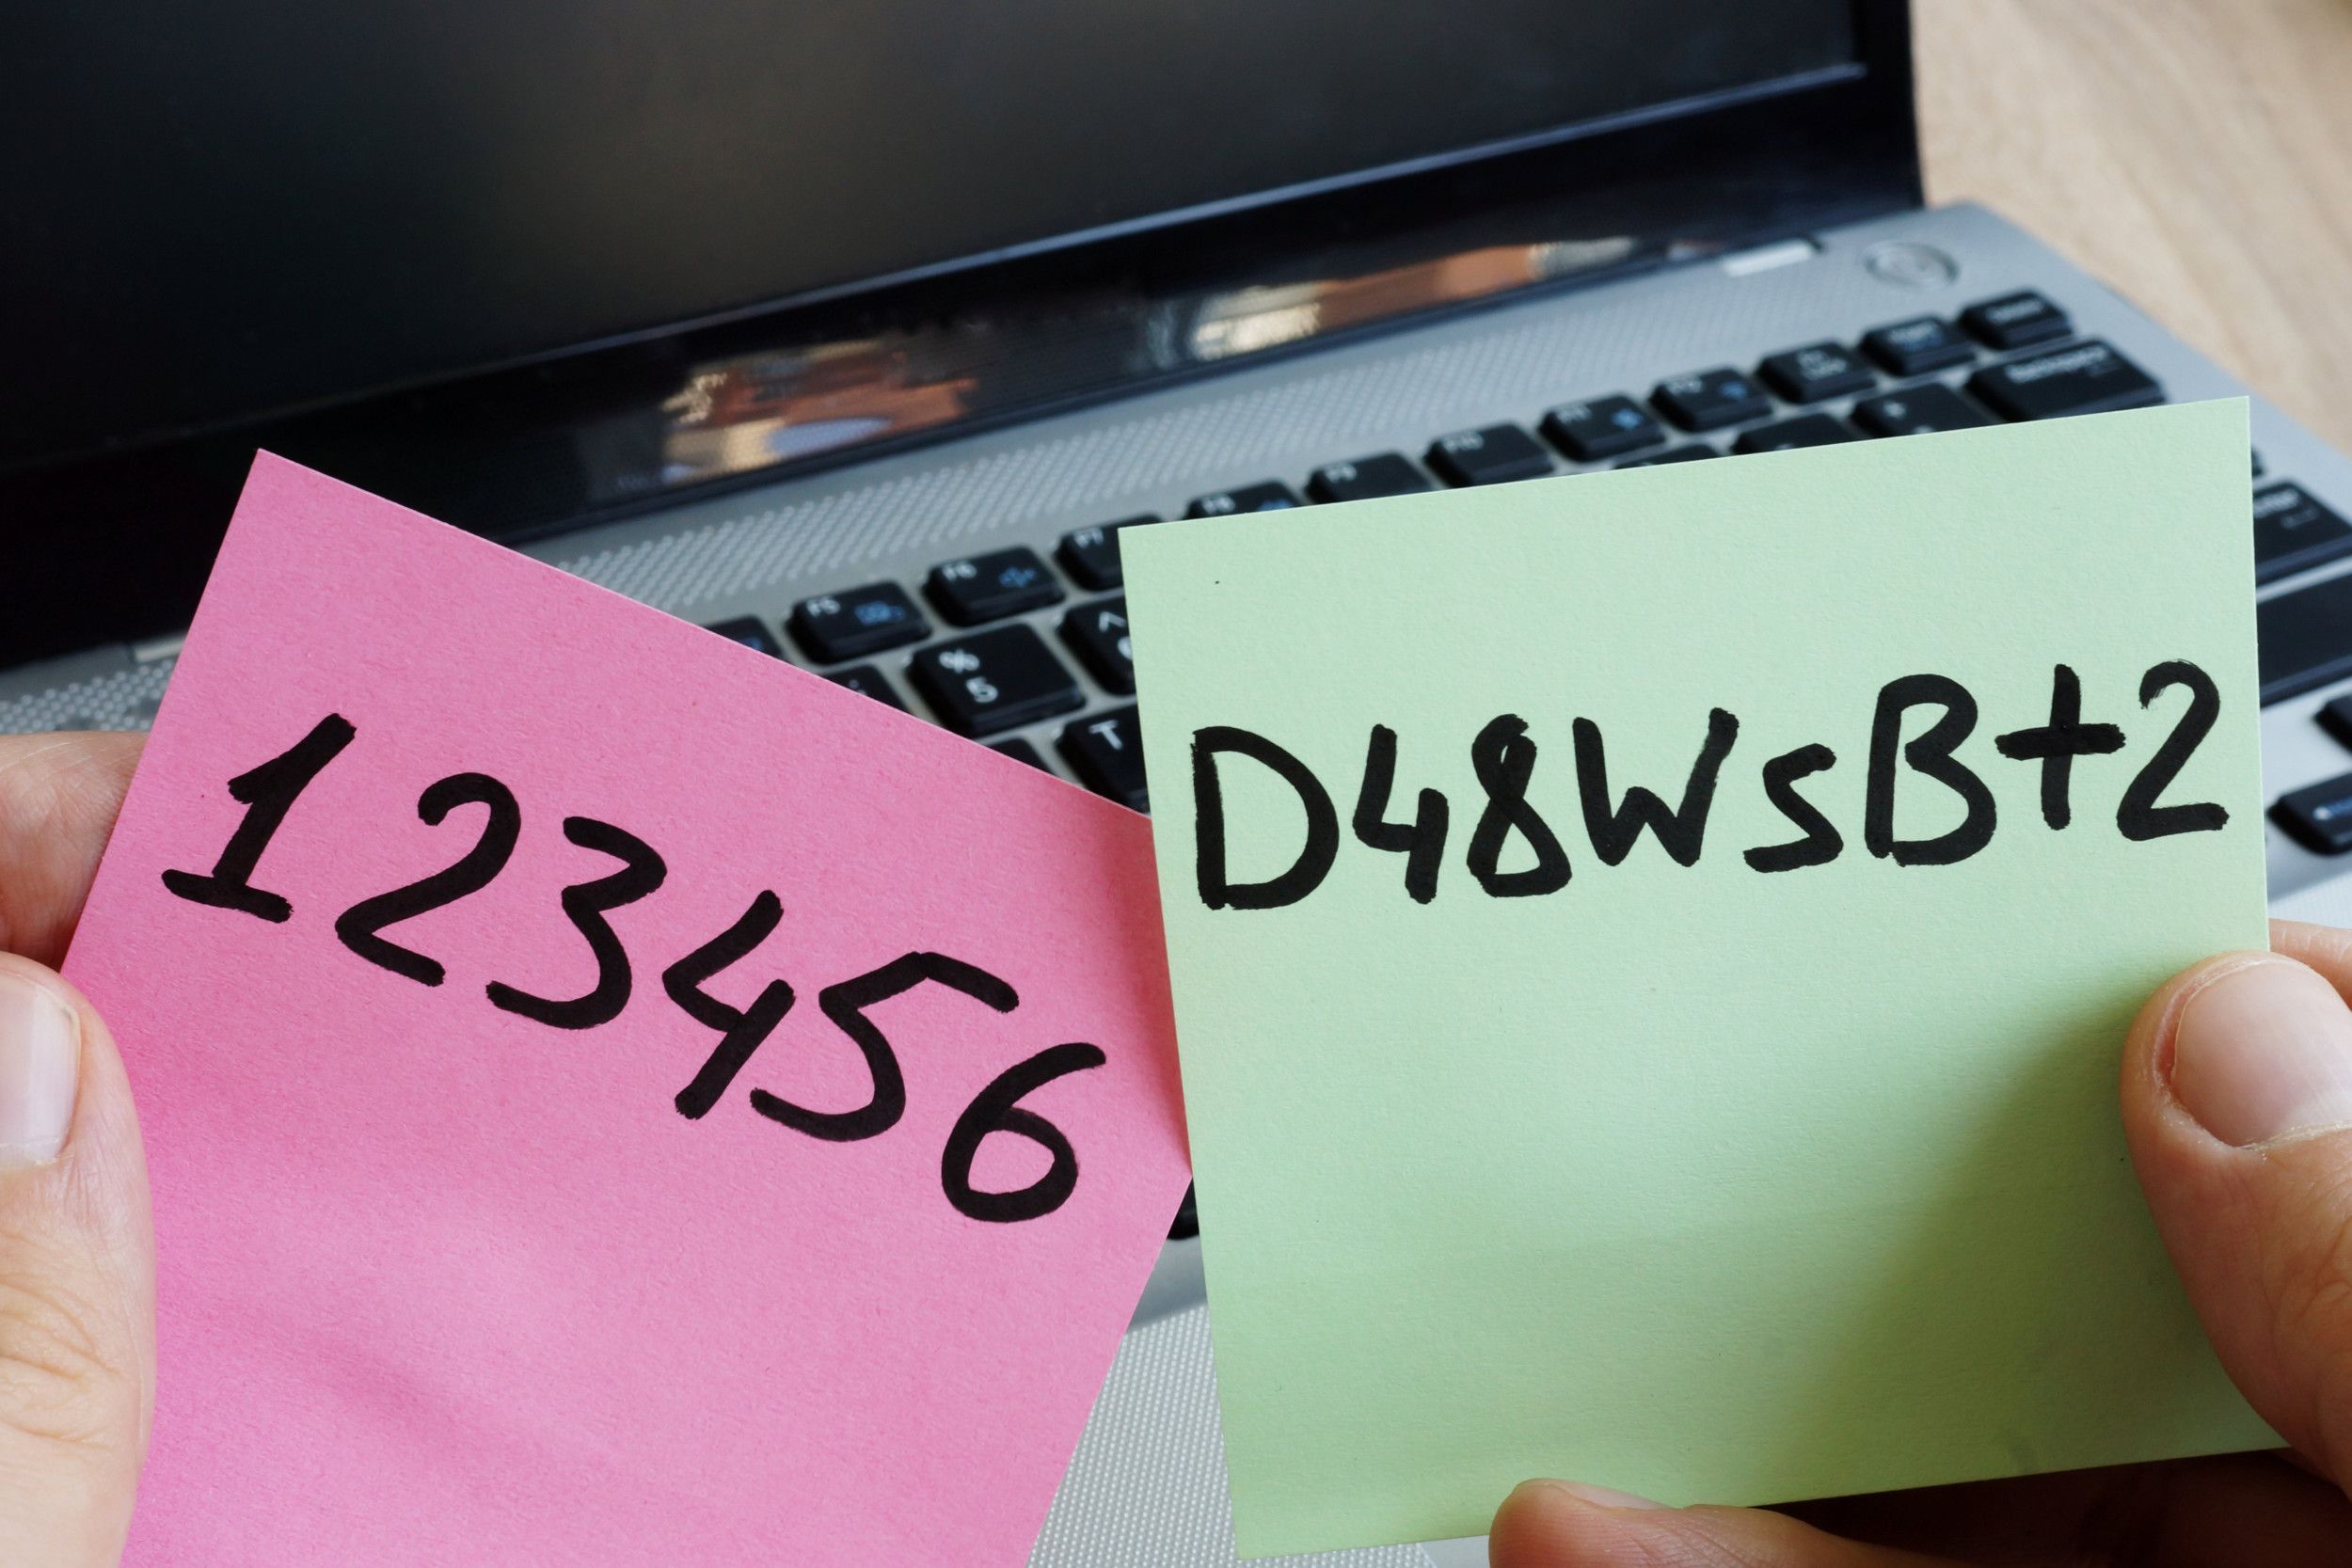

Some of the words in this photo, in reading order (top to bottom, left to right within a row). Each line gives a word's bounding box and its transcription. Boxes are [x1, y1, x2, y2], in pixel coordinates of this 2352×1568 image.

[965, 675, 999, 704] 5
[1089, 718, 1123, 750] T
[162, 713, 1106, 1224] 123456
